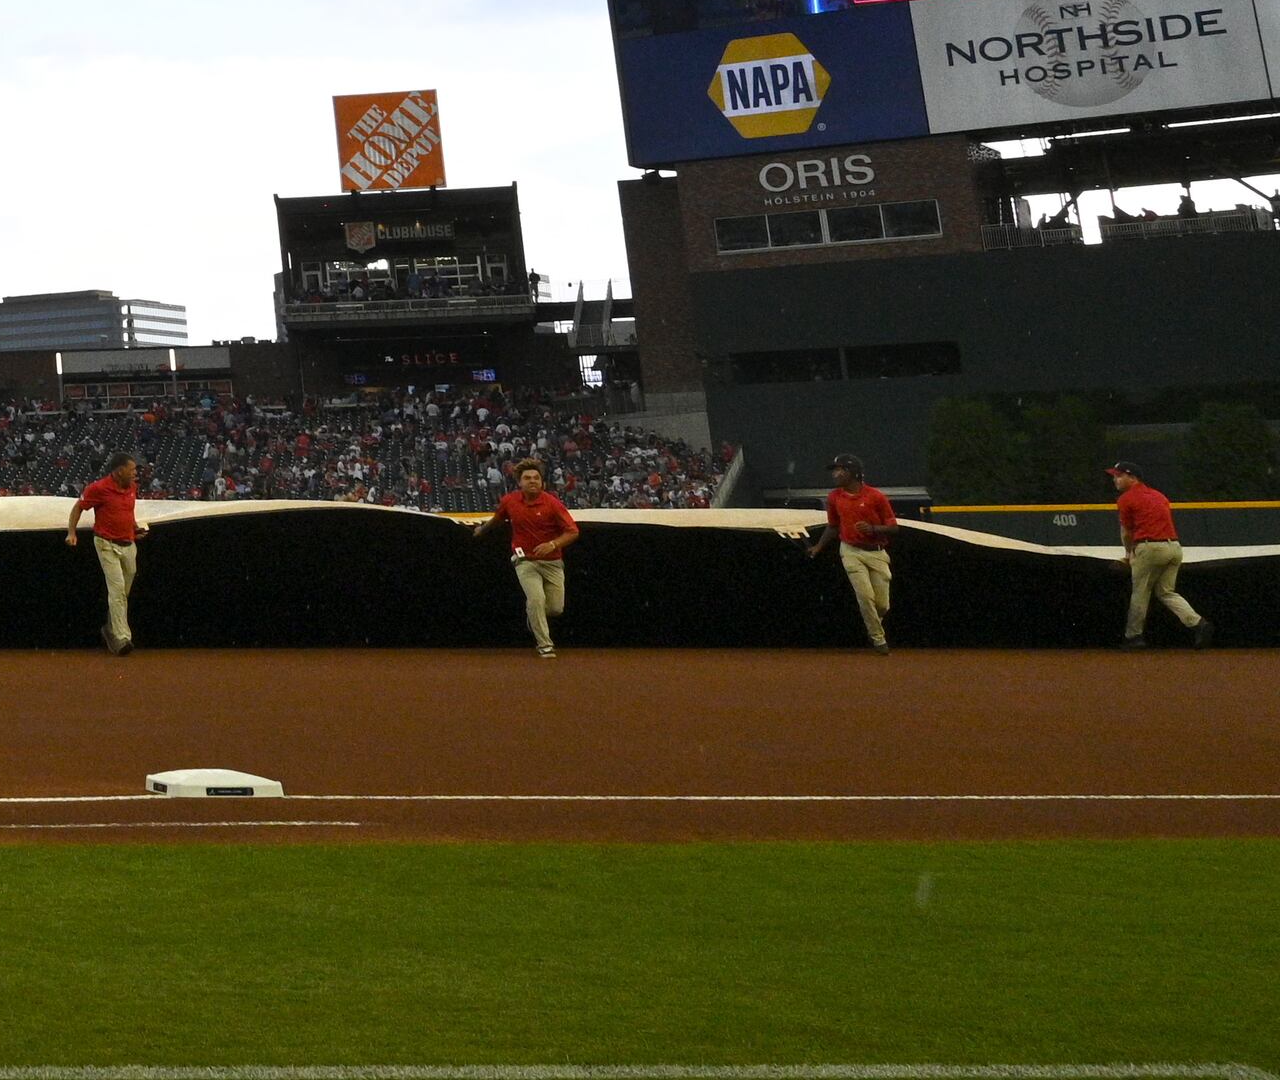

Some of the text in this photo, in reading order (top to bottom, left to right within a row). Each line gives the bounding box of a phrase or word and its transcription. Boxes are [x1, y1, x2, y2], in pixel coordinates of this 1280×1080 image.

[945, 8, 1227, 67] NORTHSIDE
[727, 61, 814, 111] NAPA
[1000, 51, 1178, 86] HOSPITAL
[341, 90, 438, 190] HOME
[347, 103, 388, 143] THE
[382, 126, 441, 189] DEPOT
[759, 154, 875, 192] ORIS
[764, 189, 876, 206] HOLSTEIN 1904
[378, 224, 453, 240] CLUBHOUSE
[401, 352, 459, 365] SLICE
[1053, 514, 1077, 526] 400
